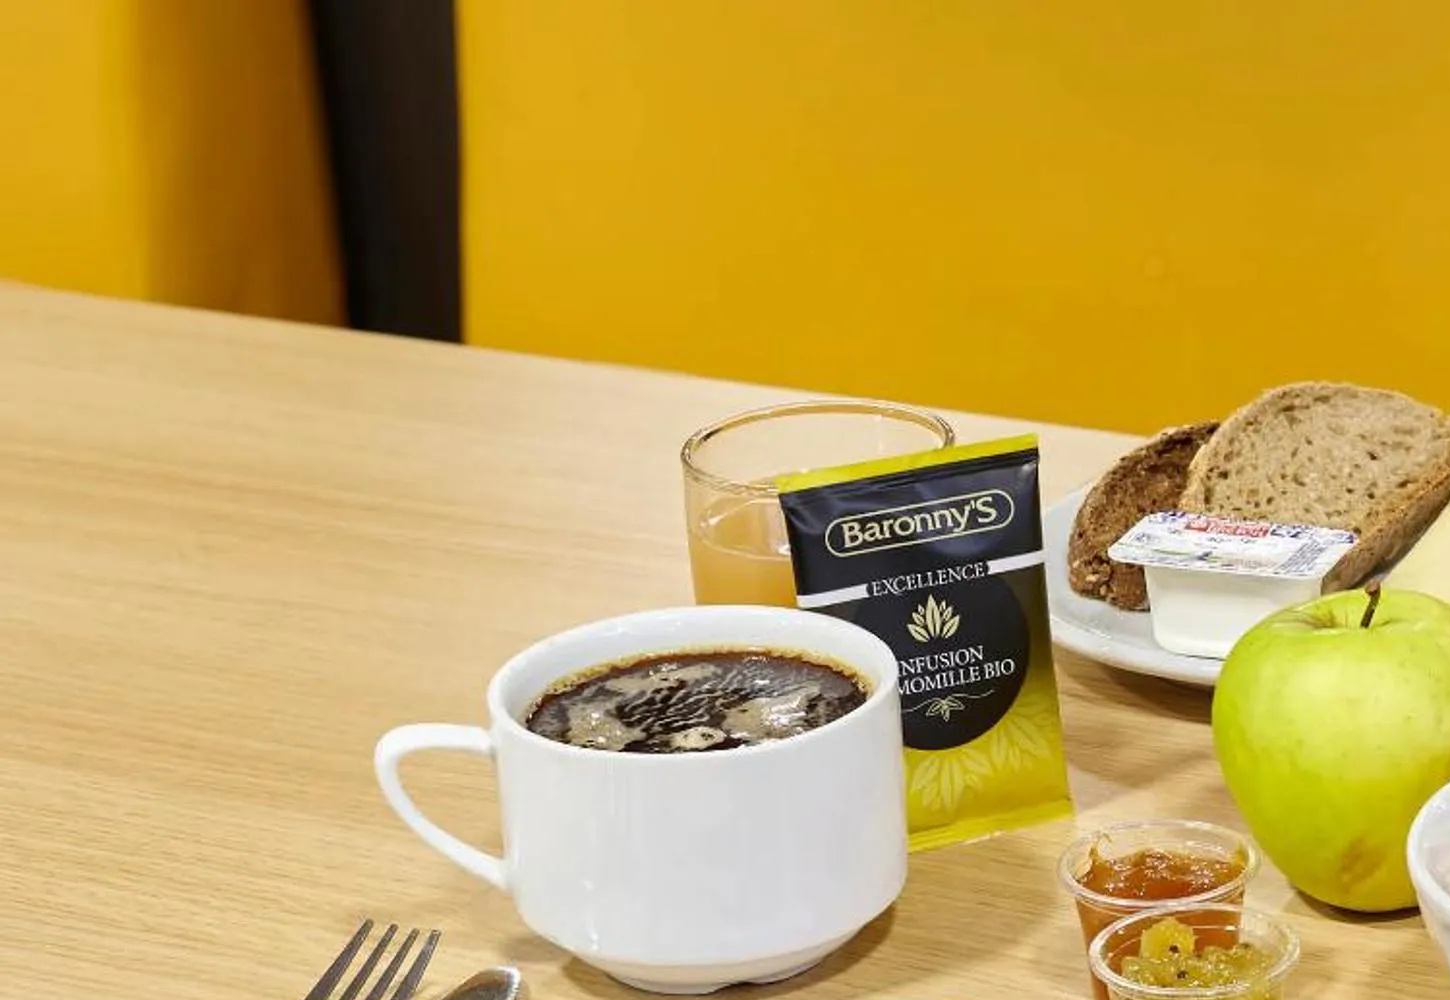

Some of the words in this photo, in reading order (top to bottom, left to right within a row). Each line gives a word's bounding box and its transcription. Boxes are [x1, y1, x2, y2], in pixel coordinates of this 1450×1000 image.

[842, 495, 998, 548] Baronny'S
[871, 562, 985, 596] EXCELLENCE
[898, 666, 981, 696] MOMILLE
[984, 658, 1016, 680] BIO
[899, 645, 984, 677] NFUSION
